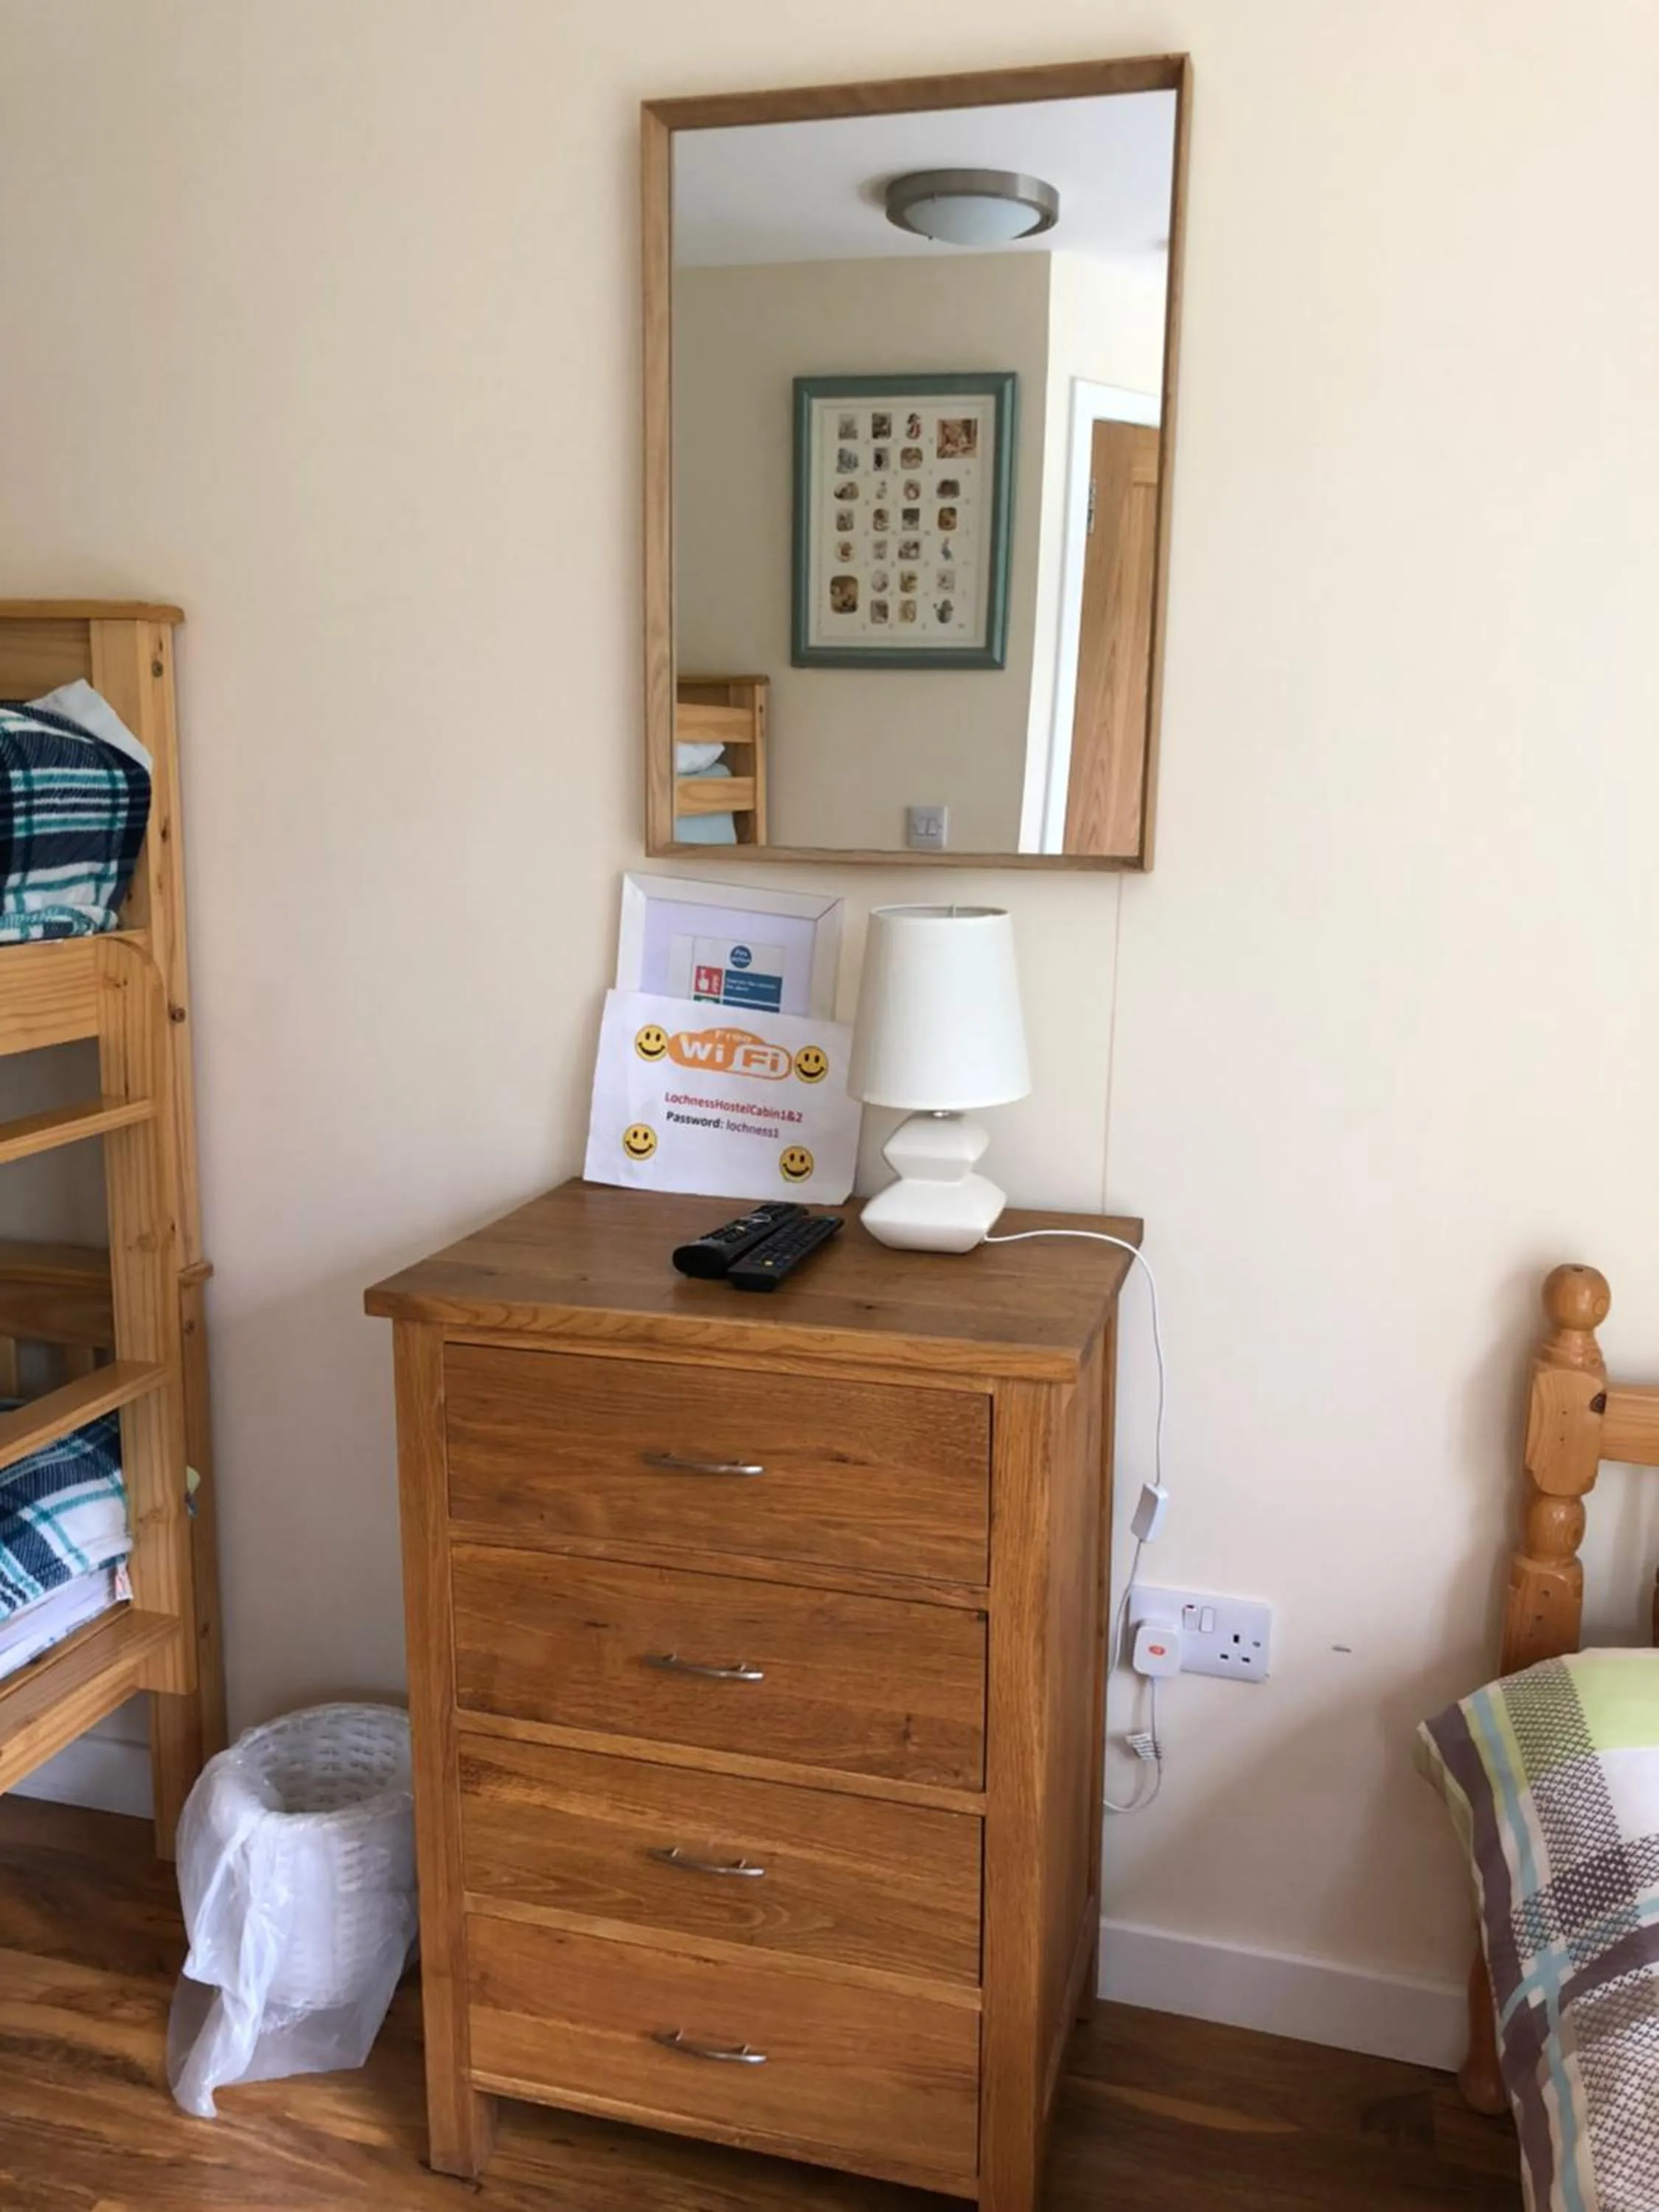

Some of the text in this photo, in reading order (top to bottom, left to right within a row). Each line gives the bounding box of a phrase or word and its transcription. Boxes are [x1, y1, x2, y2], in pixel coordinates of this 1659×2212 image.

[665, 1092, 803, 1123] LochnessHostelCabin1&2
[667, 1111, 779, 1138] Password: lochness1
